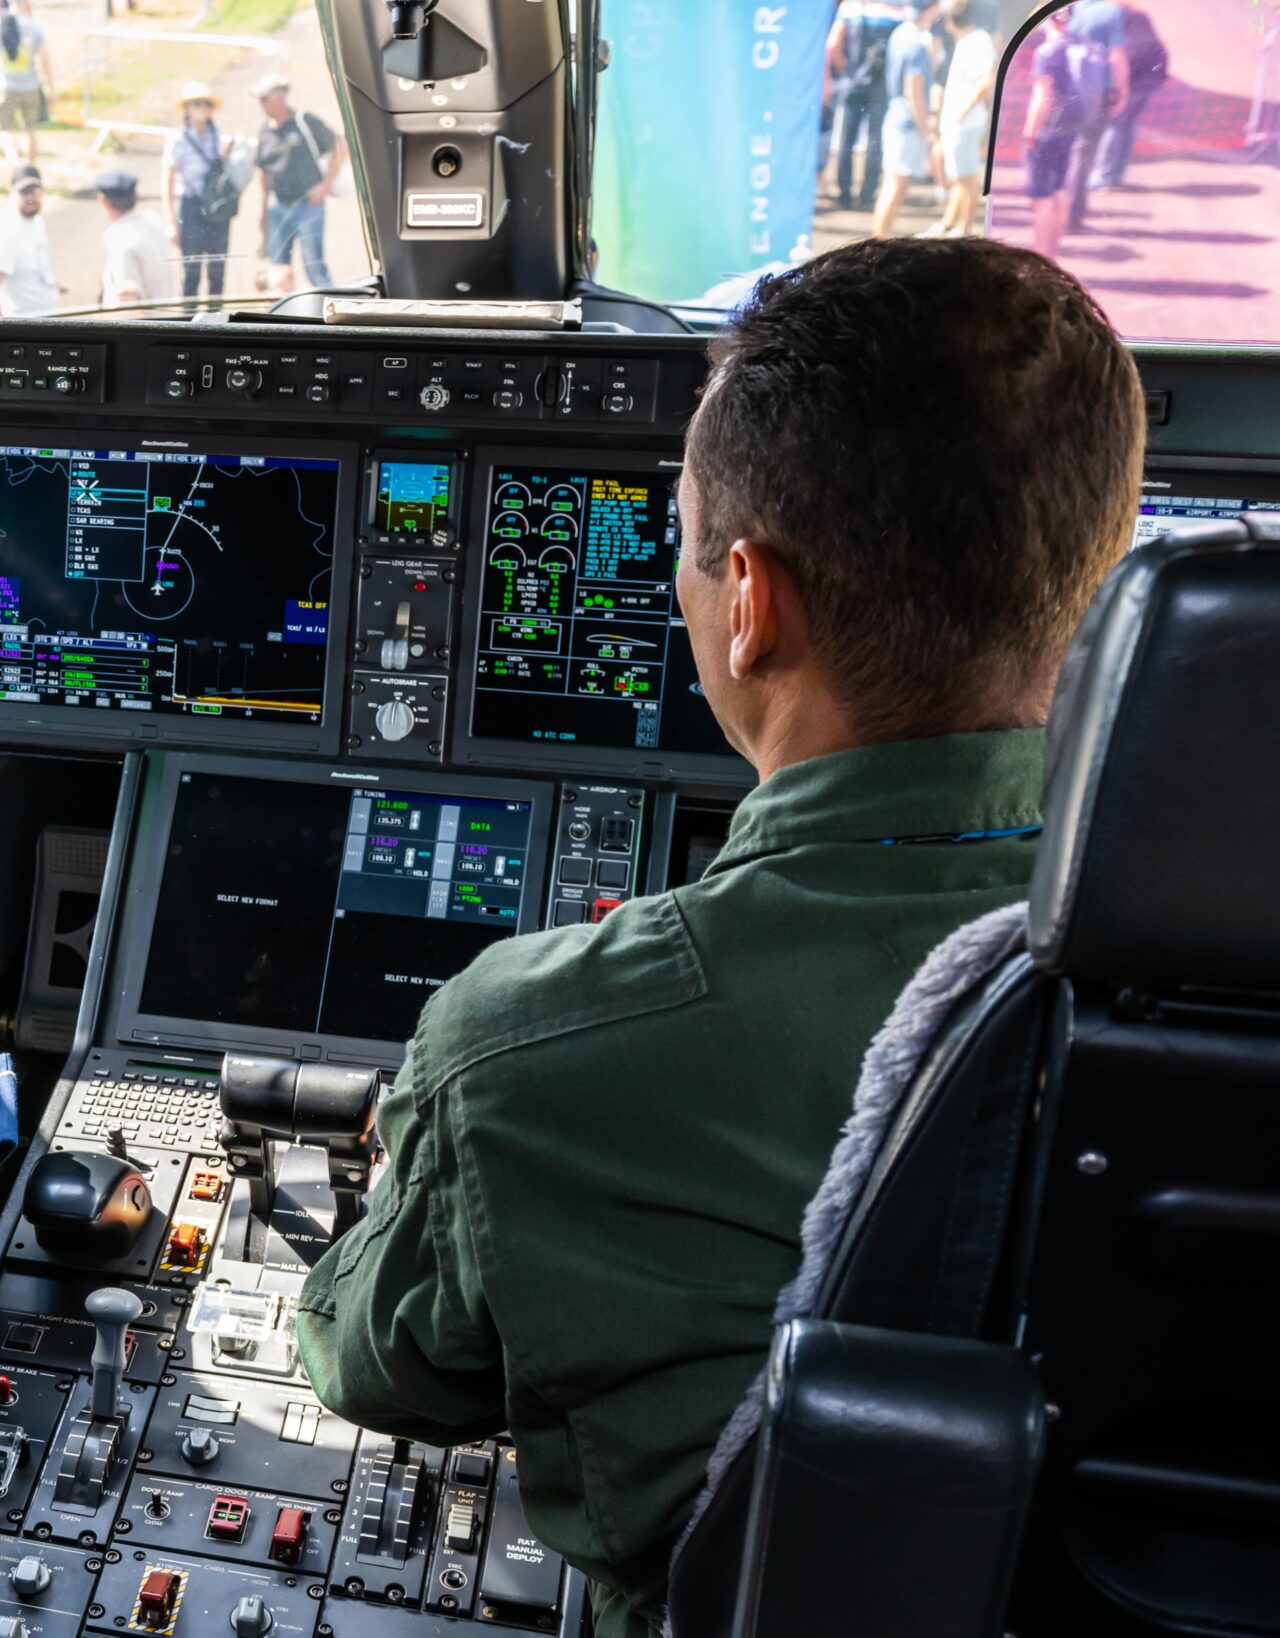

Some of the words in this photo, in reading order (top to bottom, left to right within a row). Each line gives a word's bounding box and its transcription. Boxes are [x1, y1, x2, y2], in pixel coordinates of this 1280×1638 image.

[89, 518, 114, 526] BEARING
[298, 601, 313, 609] TCAS
[381, 678, 417, 686] AUTOBRAKE
[633, 701, 642, 709] NO
[544, 731, 557, 739] ATC
[559, 732, 576, 740] COMM
[364, 791, 386, 799] TUNING
[376, 800, 408, 810] 121.600
[470, 822, 491, 831] DATA
[412, 869, 429, 877] HOLD
[503, 878, 520, 886] HOLD
[217, 894, 239, 903] SELECT
[241, 896, 253, 904] NEW
[255, 898, 278, 906] FORMAT
[384, 974, 408, 984] SELECT
[410, 976, 424, 985] NEW
[285, 1233, 298, 1241] MIN
[298, 1234, 314, 1243] REV
[280, 1262, 297, 1271] MAX
[39, 1313, 62, 1322] FLIGHT
[16, 1367, 38, 1376] BRAKE
[218, 1437, 236, 1445] RIGHT
[103, 1490, 120, 1498] FULL
[141, 1486, 161, 1494] DOOR
[167, 1490, 184, 1498] RAMP
[195, 1483, 223, 1492] CARGO
[224, 1486, 248, 1496] DOOR
[255, 1492, 276, 1500] RAMP
[458, 1490, 477, 1498] FLAP
[276, 1500, 292, 1509] GND
[293, 1503, 318, 1513] ENABLE
[351, 1508, 358, 1516] 3
[60, 1514, 81, 1522] OPEN
[341, 1535, 358, 1544] FULL
[517, 1538, 536, 1547] RAT
[506, 1544, 545, 1556] MANUAL
[506, 1552, 544, 1564] DEPLOY
